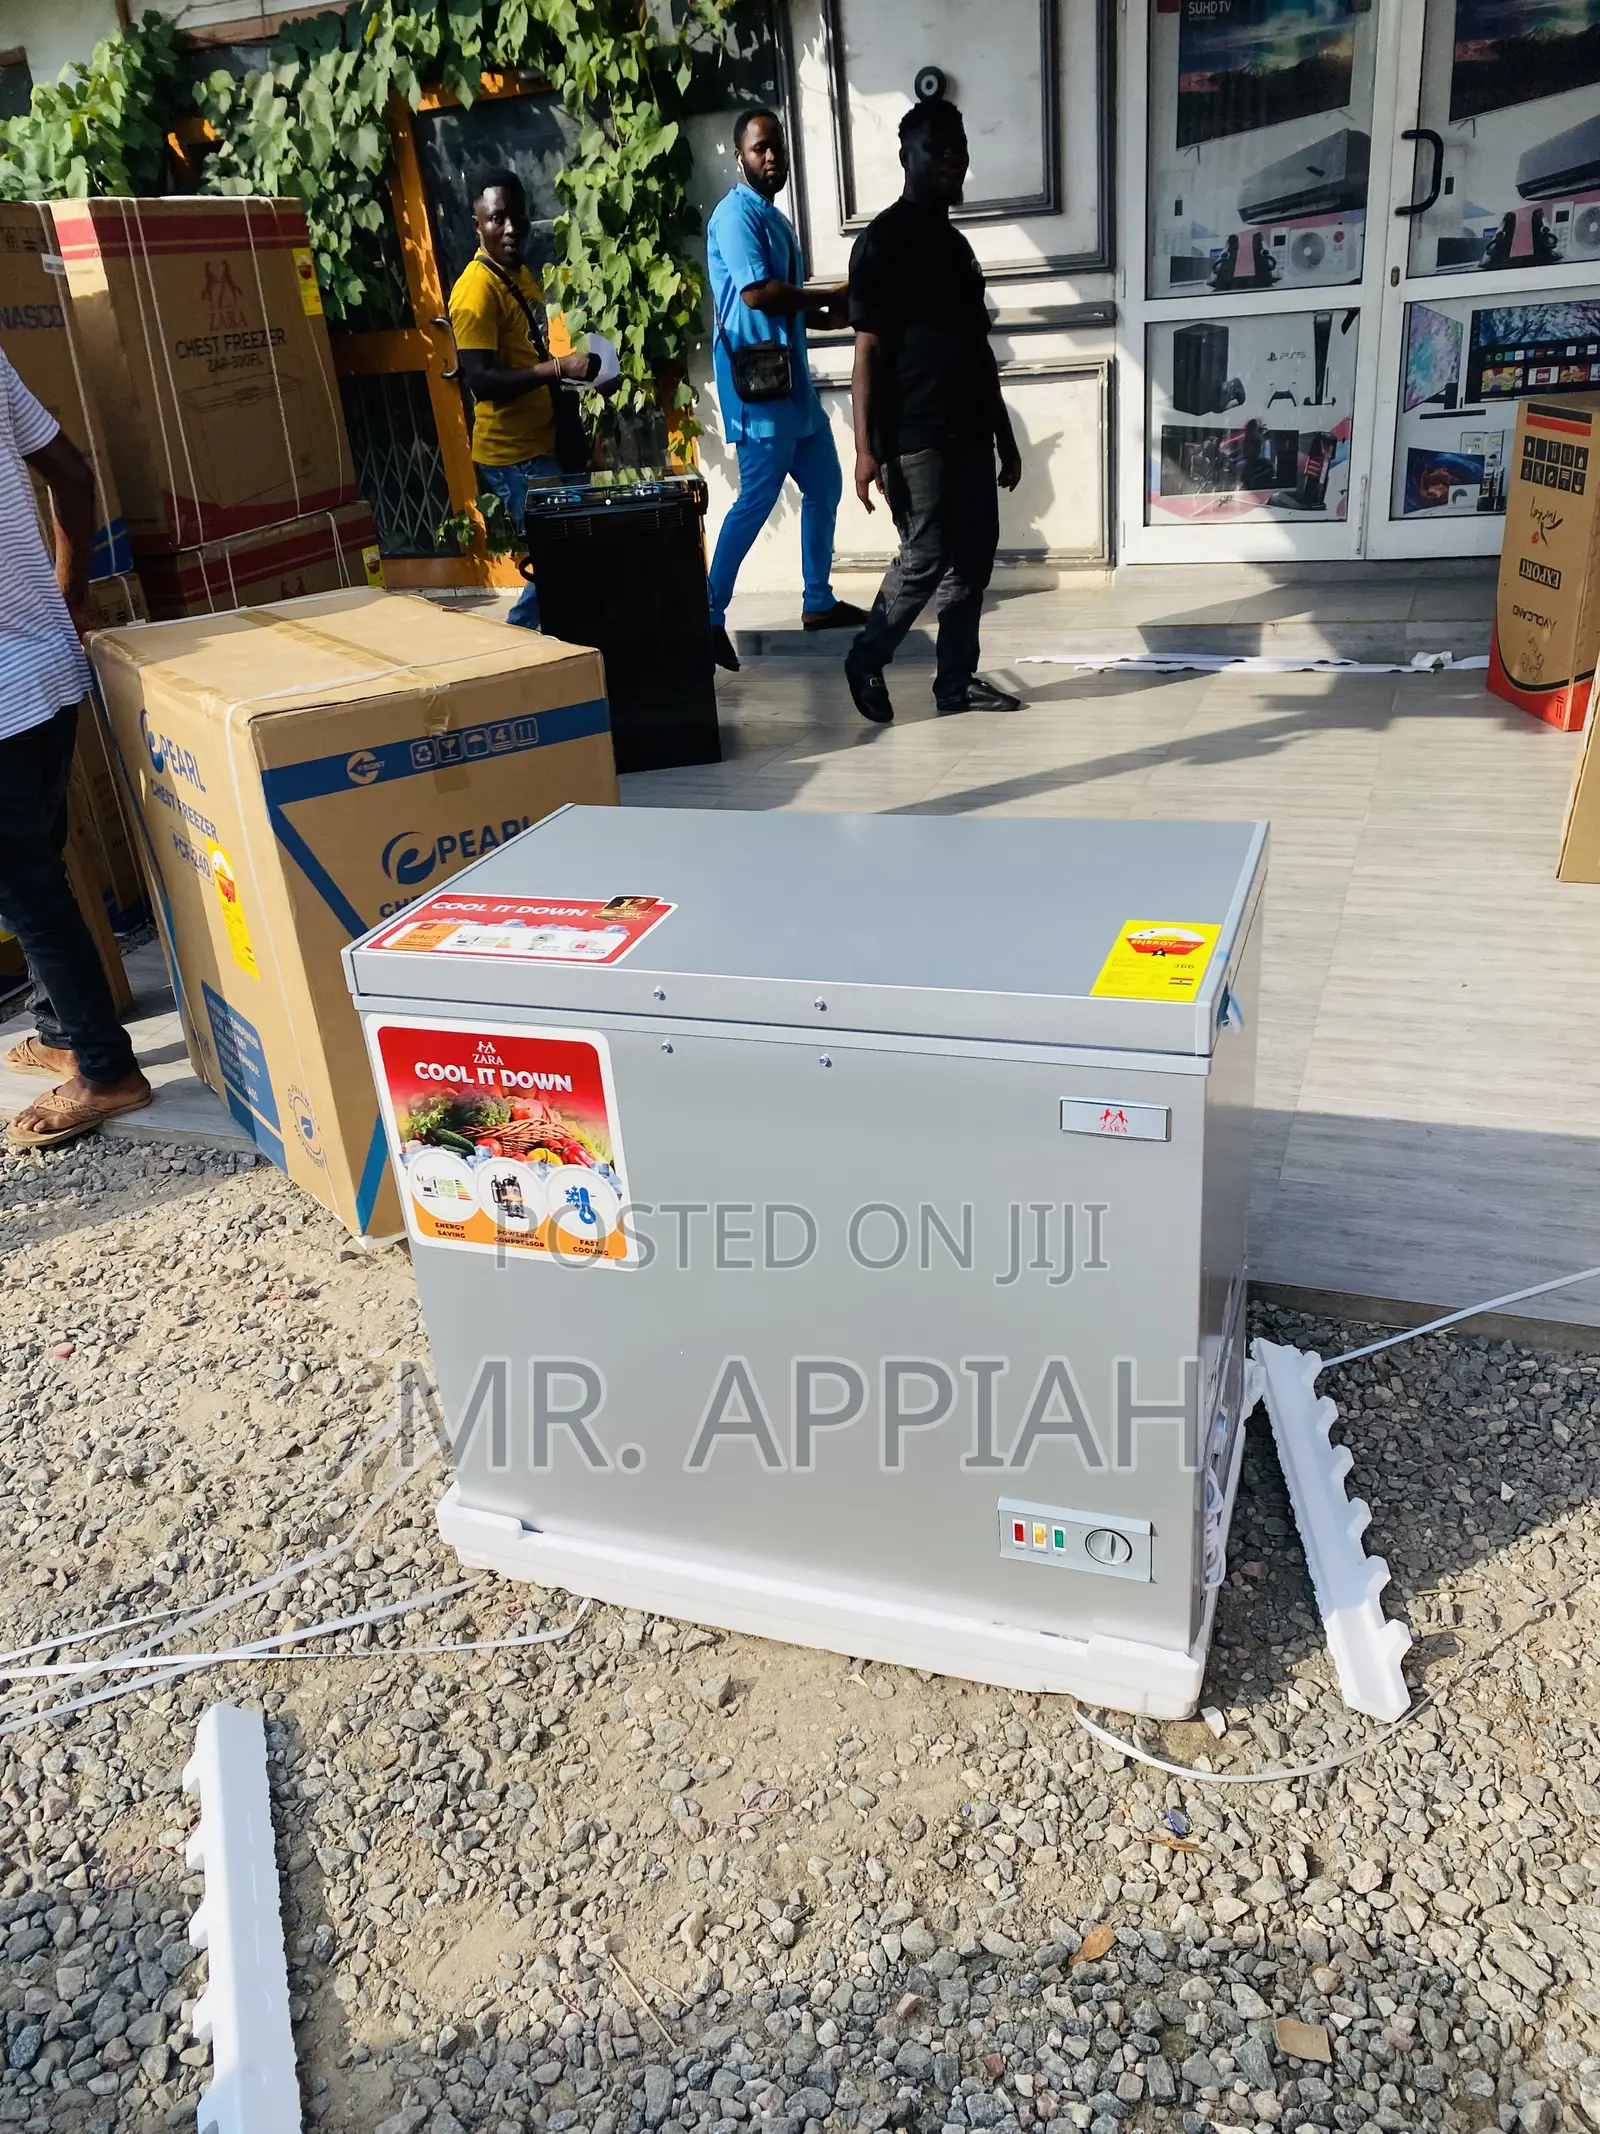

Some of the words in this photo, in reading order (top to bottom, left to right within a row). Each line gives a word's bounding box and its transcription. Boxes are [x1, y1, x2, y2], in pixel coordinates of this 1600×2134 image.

[1219, 0, 1231, 13] TV
[209, 309, 248, 331] ZARA
[176, 336, 219, 359] CHEST
[224, 328, 287, 352] FREEZER
[1521, 560, 1560, 588] EXPORT
[160, 733, 207, 793] PEARL
[431, 901, 488, 912] COOL
[492, 904, 517, 913] IT
[514, 906, 589, 917] DOWN
[1131, 939, 1176, 948] ENERGY
[472, 1053, 504, 1065] ZARA
[415, 1061, 475, 1084] COOL
[477, 1067, 496, 1086] IT
[500, 1069, 573, 1092] DOWN
[1101, 1123, 1128, 1133] ZARA
[435, 1222, 465, 1231] ENERGY
[437, 1230, 466, 1239] SAVING
[497, 1229, 539, 1240] POWERFUL
[494, 1236, 545, 1248] COMPRESSOR
[579, 1239, 600, 1247] FAST
[572, 1246, 609, 1256] COOLING
